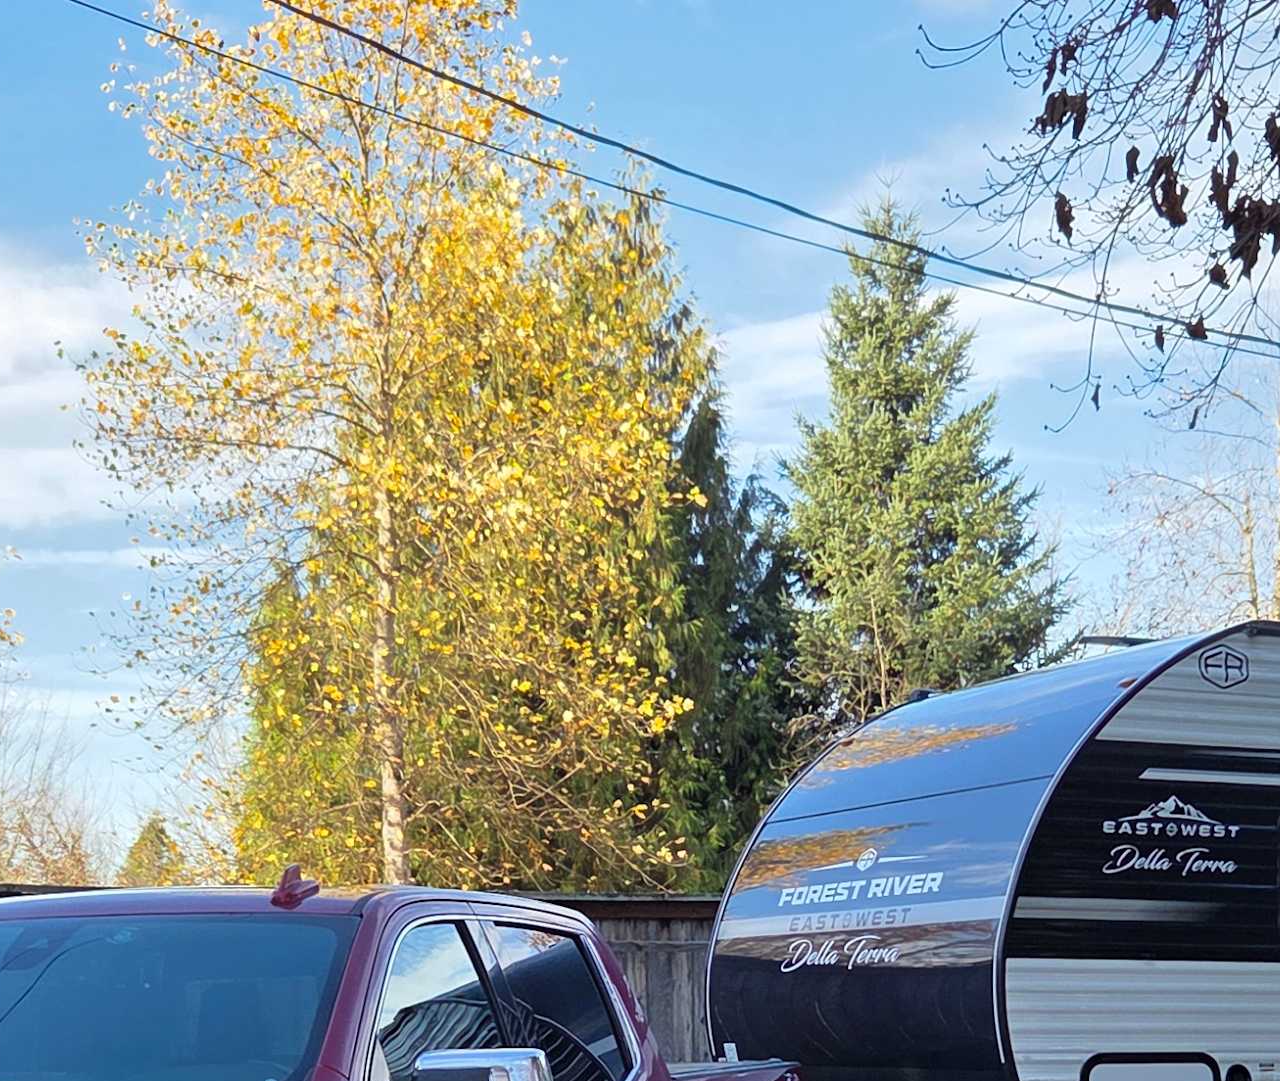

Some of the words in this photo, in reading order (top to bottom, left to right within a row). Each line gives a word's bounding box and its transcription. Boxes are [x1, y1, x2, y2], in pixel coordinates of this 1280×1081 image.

[1102, 844, 1171, 874] Della
[1176, 848, 1238, 877] Terra
[778, 880, 867, 906] FOREST
[867, 872, 943, 898] RIVER
[780, 939, 840, 973] Della
[843, 935, 901, 970] Terra
